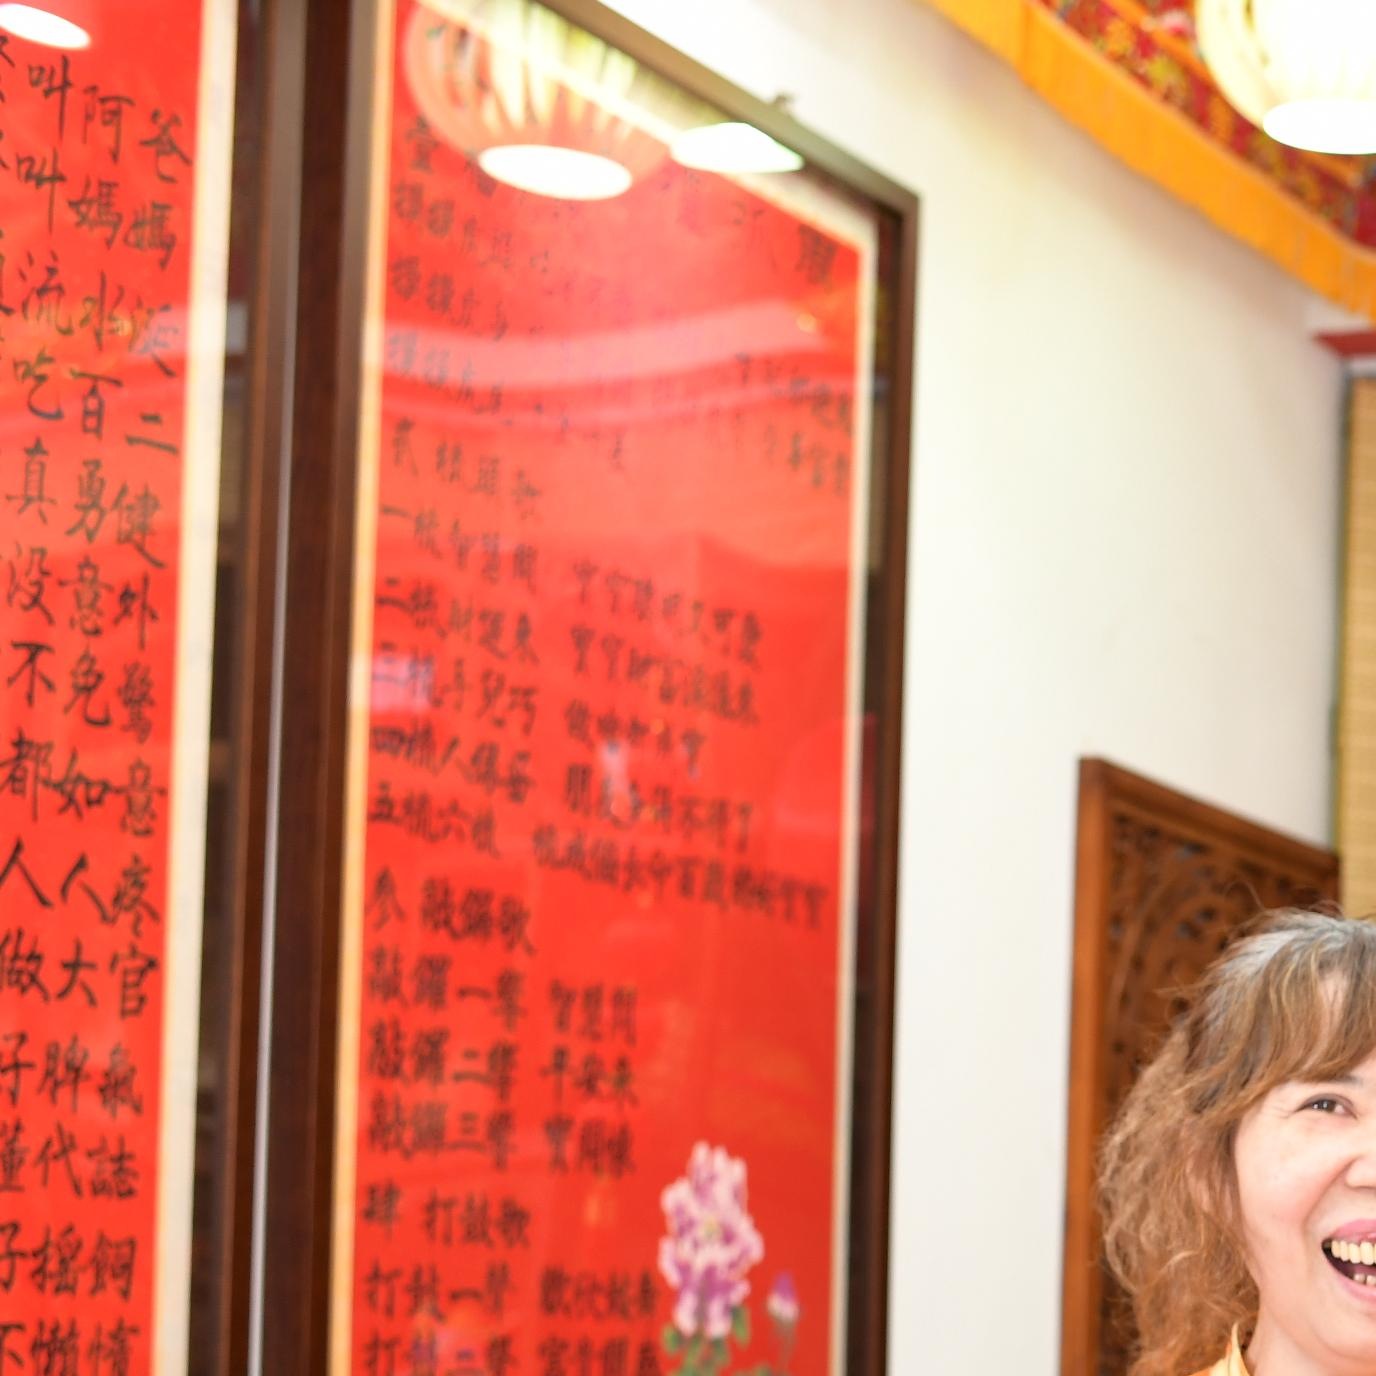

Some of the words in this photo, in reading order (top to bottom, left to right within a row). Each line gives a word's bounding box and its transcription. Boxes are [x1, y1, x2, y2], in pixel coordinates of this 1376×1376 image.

[0, 35, 193, 183] 叫阿爸
[0, 134, 177, 270] 叫媽媽
[0, 835, 160, 937] 人人疼
